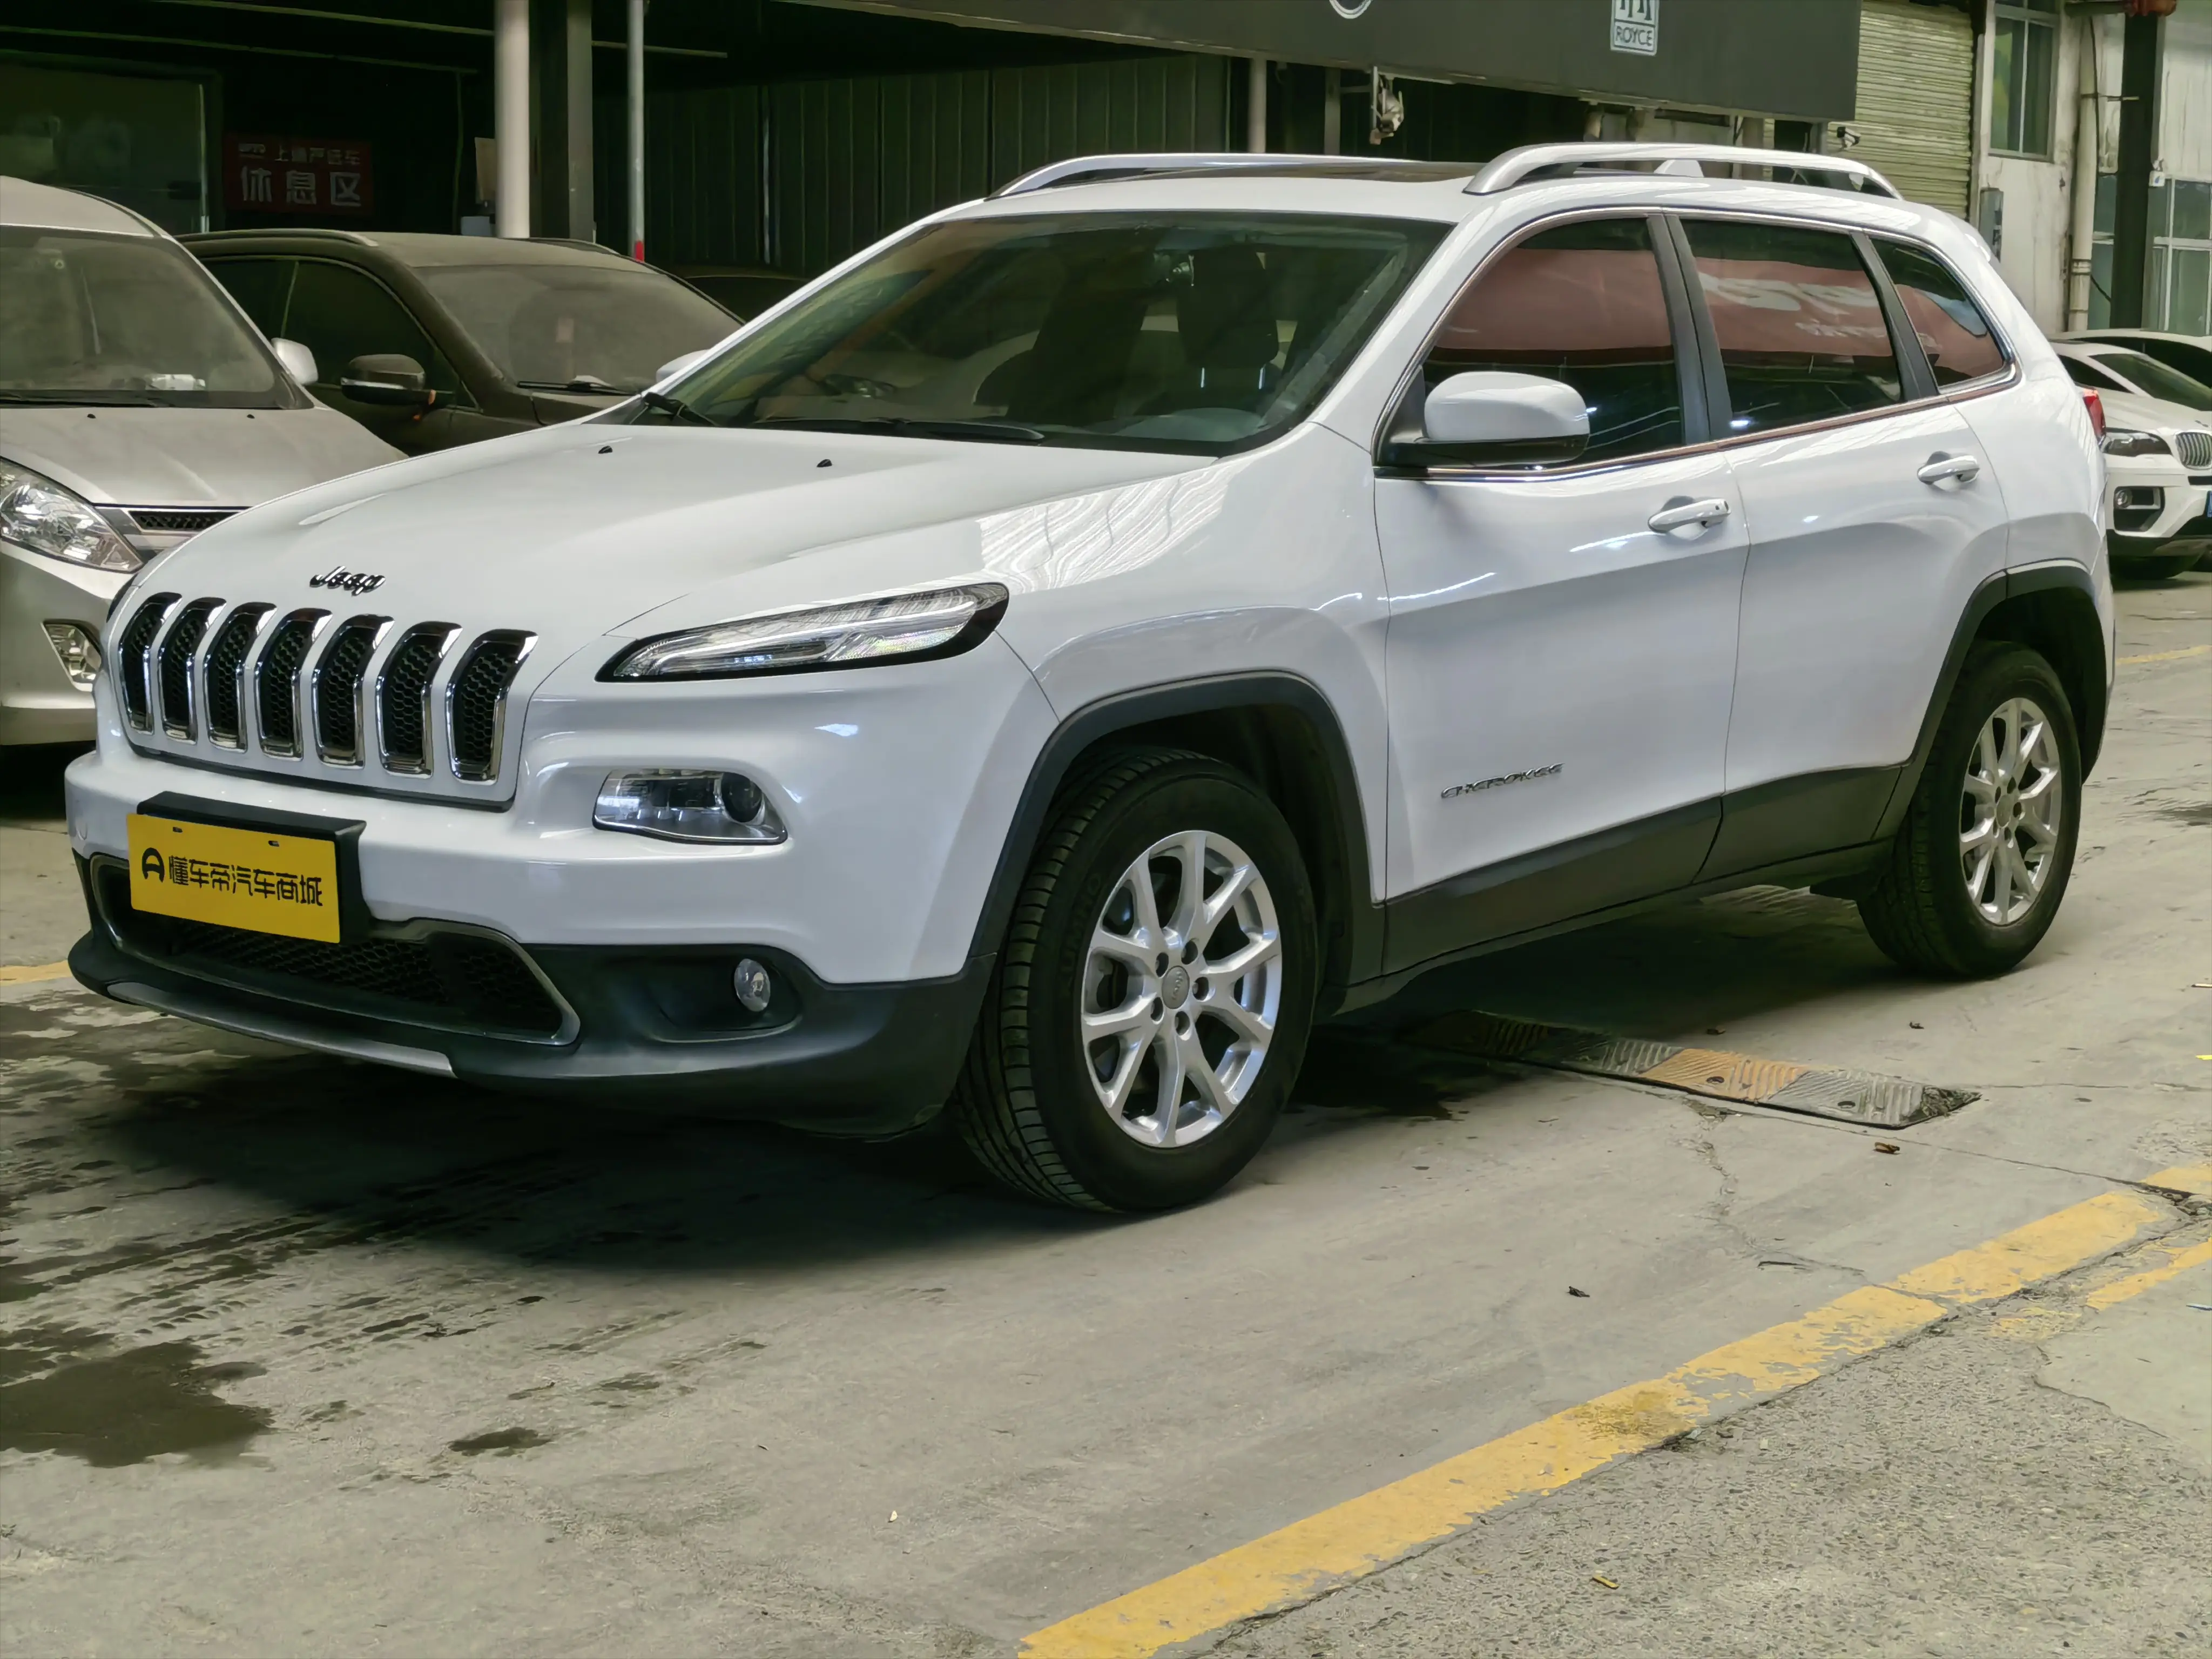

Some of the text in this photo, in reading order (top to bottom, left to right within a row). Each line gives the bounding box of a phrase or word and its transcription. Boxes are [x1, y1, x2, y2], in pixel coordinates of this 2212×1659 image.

[1615, 25, 1653, 46] ROYCE
[240, 165, 361, 206] 休息区
[309, 565, 386, 597] Jeep
[168, 855, 323, 907] 懂车帝汽车商城
